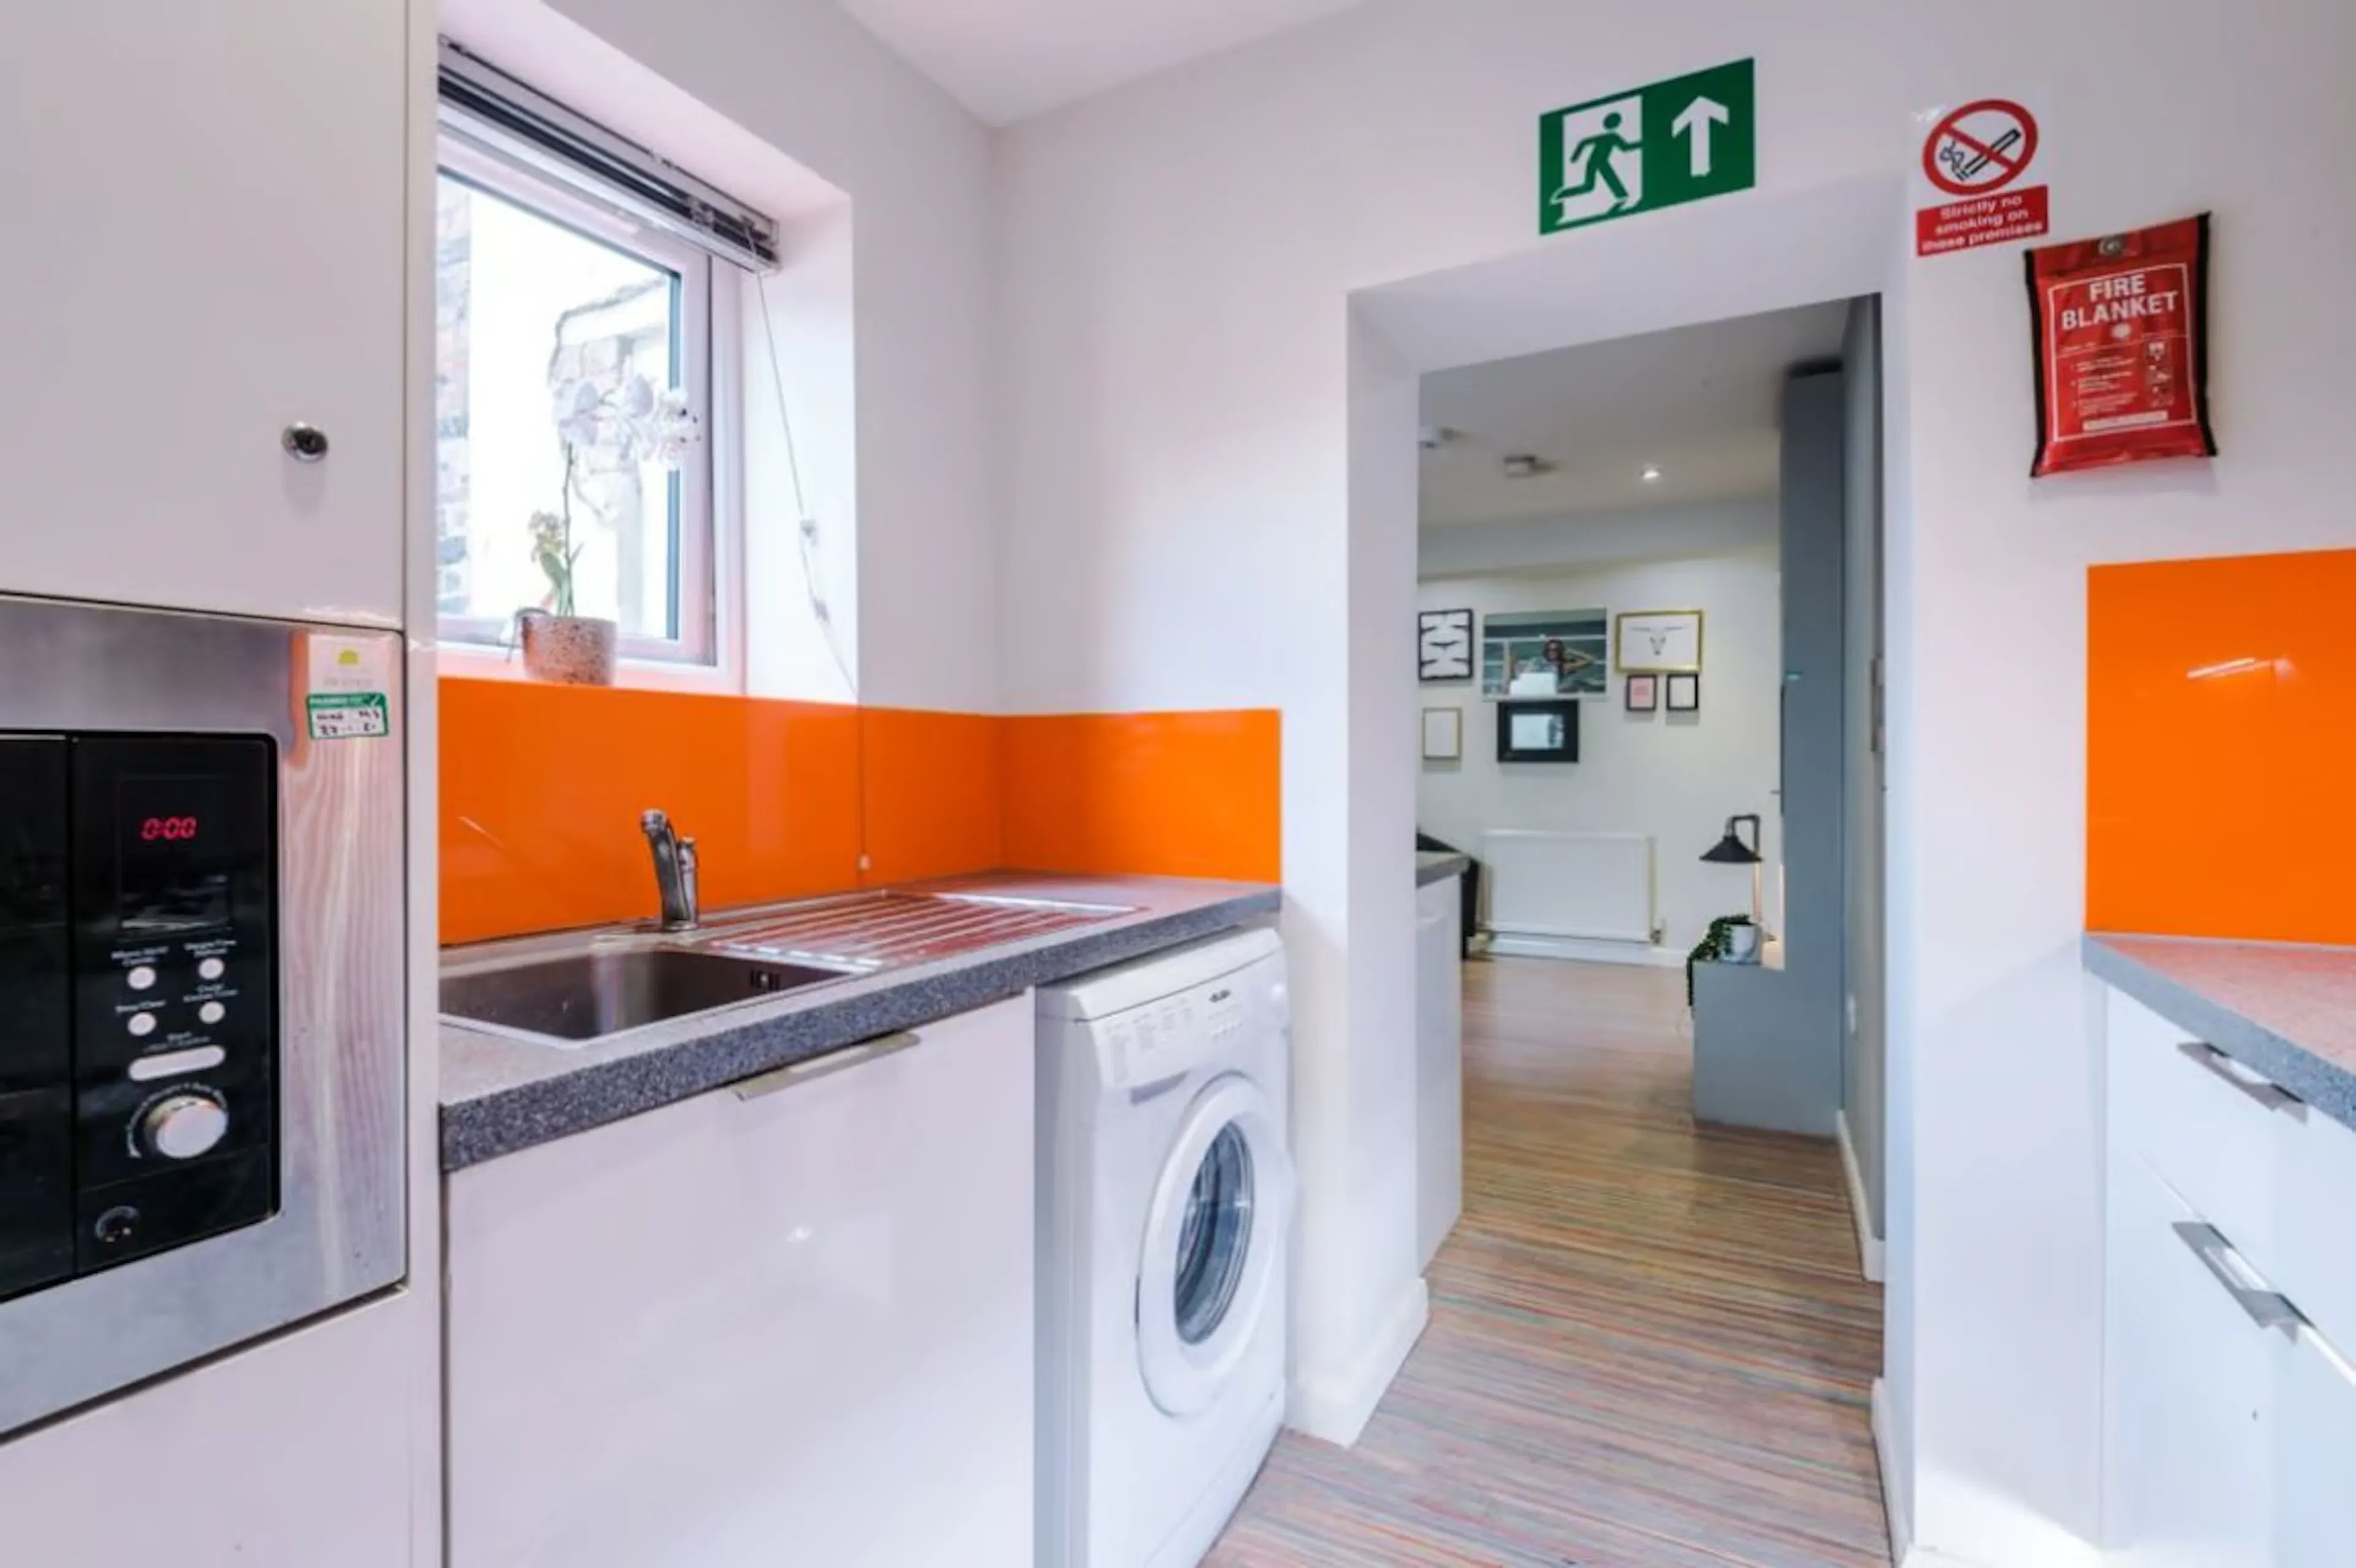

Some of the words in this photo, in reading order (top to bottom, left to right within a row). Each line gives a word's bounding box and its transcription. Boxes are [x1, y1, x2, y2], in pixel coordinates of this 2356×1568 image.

[1941, 199, 1996, 220] Strictly
[2001, 195, 2022, 207] no
[1934, 214, 2004, 236] smoking
[2007, 209, 2028, 221] on
[2089, 274, 2146, 302] FIRE
[2062, 290, 2178, 331] BLANKET
